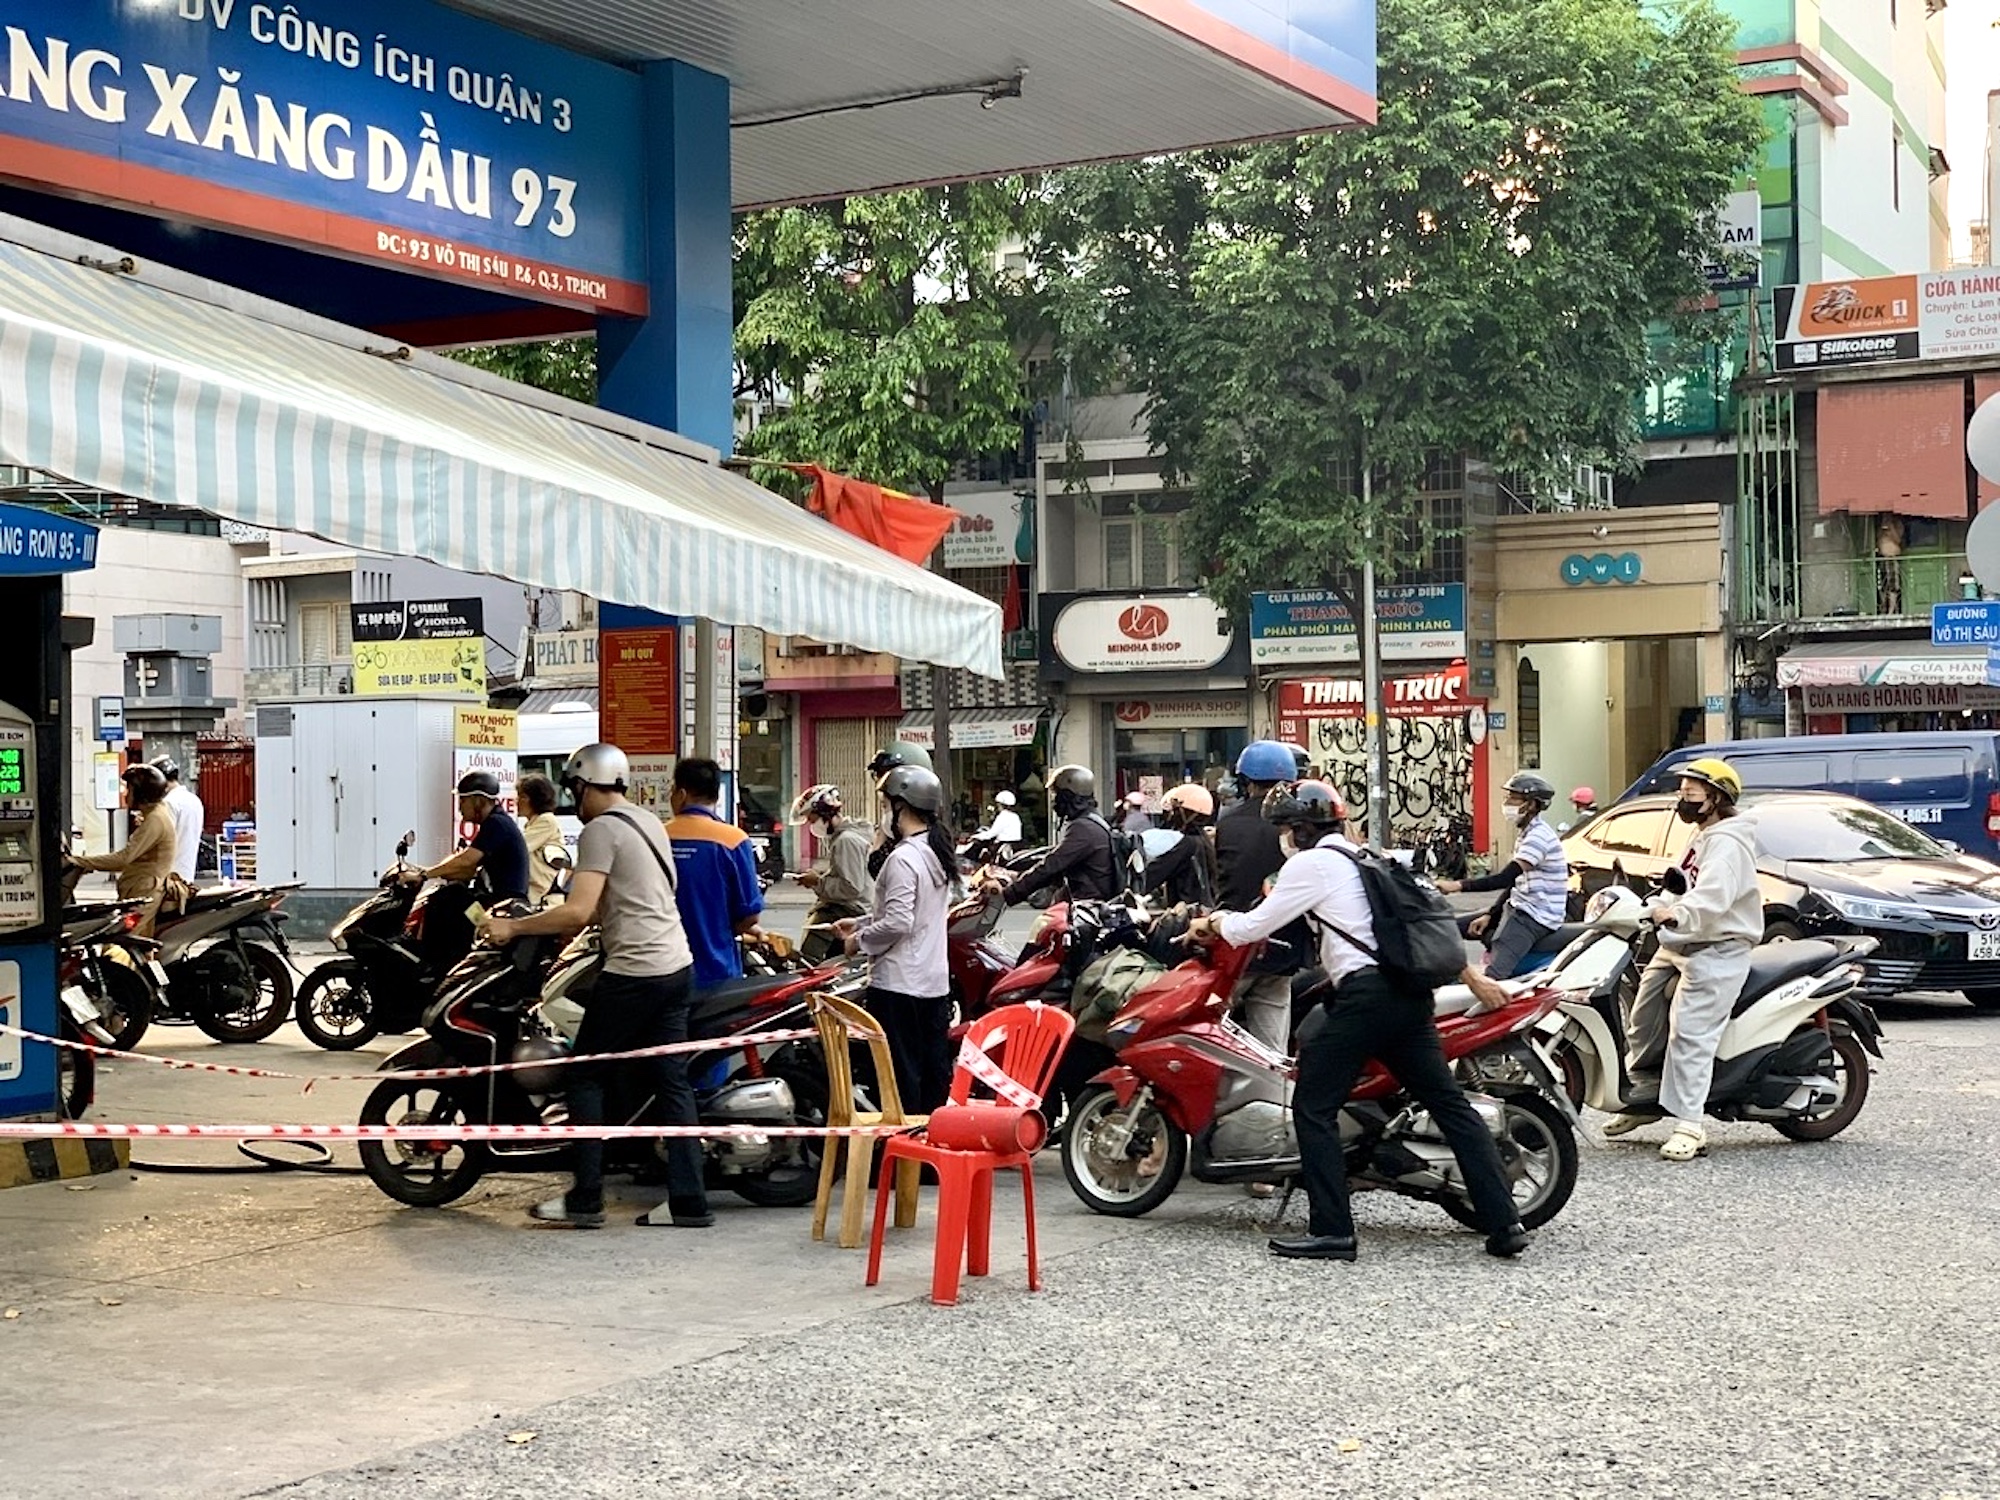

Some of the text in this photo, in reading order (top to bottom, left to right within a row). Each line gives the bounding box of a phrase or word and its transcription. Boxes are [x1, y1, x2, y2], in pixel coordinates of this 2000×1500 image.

[251, 4, 359, 69] CÔNG
[374, 34, 435, 92] ÍCH
[449, 66, 542, 125] QUẬN
[553, 98, 572, 133] 3
[0, 26, 577, 238] NG XĂNG DẦU 93
[1723, 227, 1753, 243] AM
[410, 242, 430, 261] 93
[434, 243, 455, 266] VÕ
[459, 251, 481, 277] THỊ
[565, 276, 607, 300] TP.HCM
[1925, 275, 1957, 298] CỬA
[1955, 313, 1975, 324] Các
[1821, 336, 1896, 355] Silkolene
[28, 528, 57, 558] RON
[59, 531, 75, 560] 95
[424, 616, 468, 626] HONDA
[1946, 606, 1988, 620] ĐƯỜNG
[1936, 624, 1952, 641] VÕ
[1974, 621, 1998, 641] SÁU
[536, 633, 579, 666] PHÁT
[637, 647, 655, 660] QUY
[1108, 642, 1182, 654] MINHHA SHOP
[1301, 672, 1461, 705] THAN TRÚC
[1927, 686, 1959, 705] NAM
[1154, 700, 1242, 713] MINHHA SHOP
[461, 713, 515, 726] THAY NHỚT
[469, 731, 505, 746] RỬA XE
[1012, 723, 1034, 737] 154
